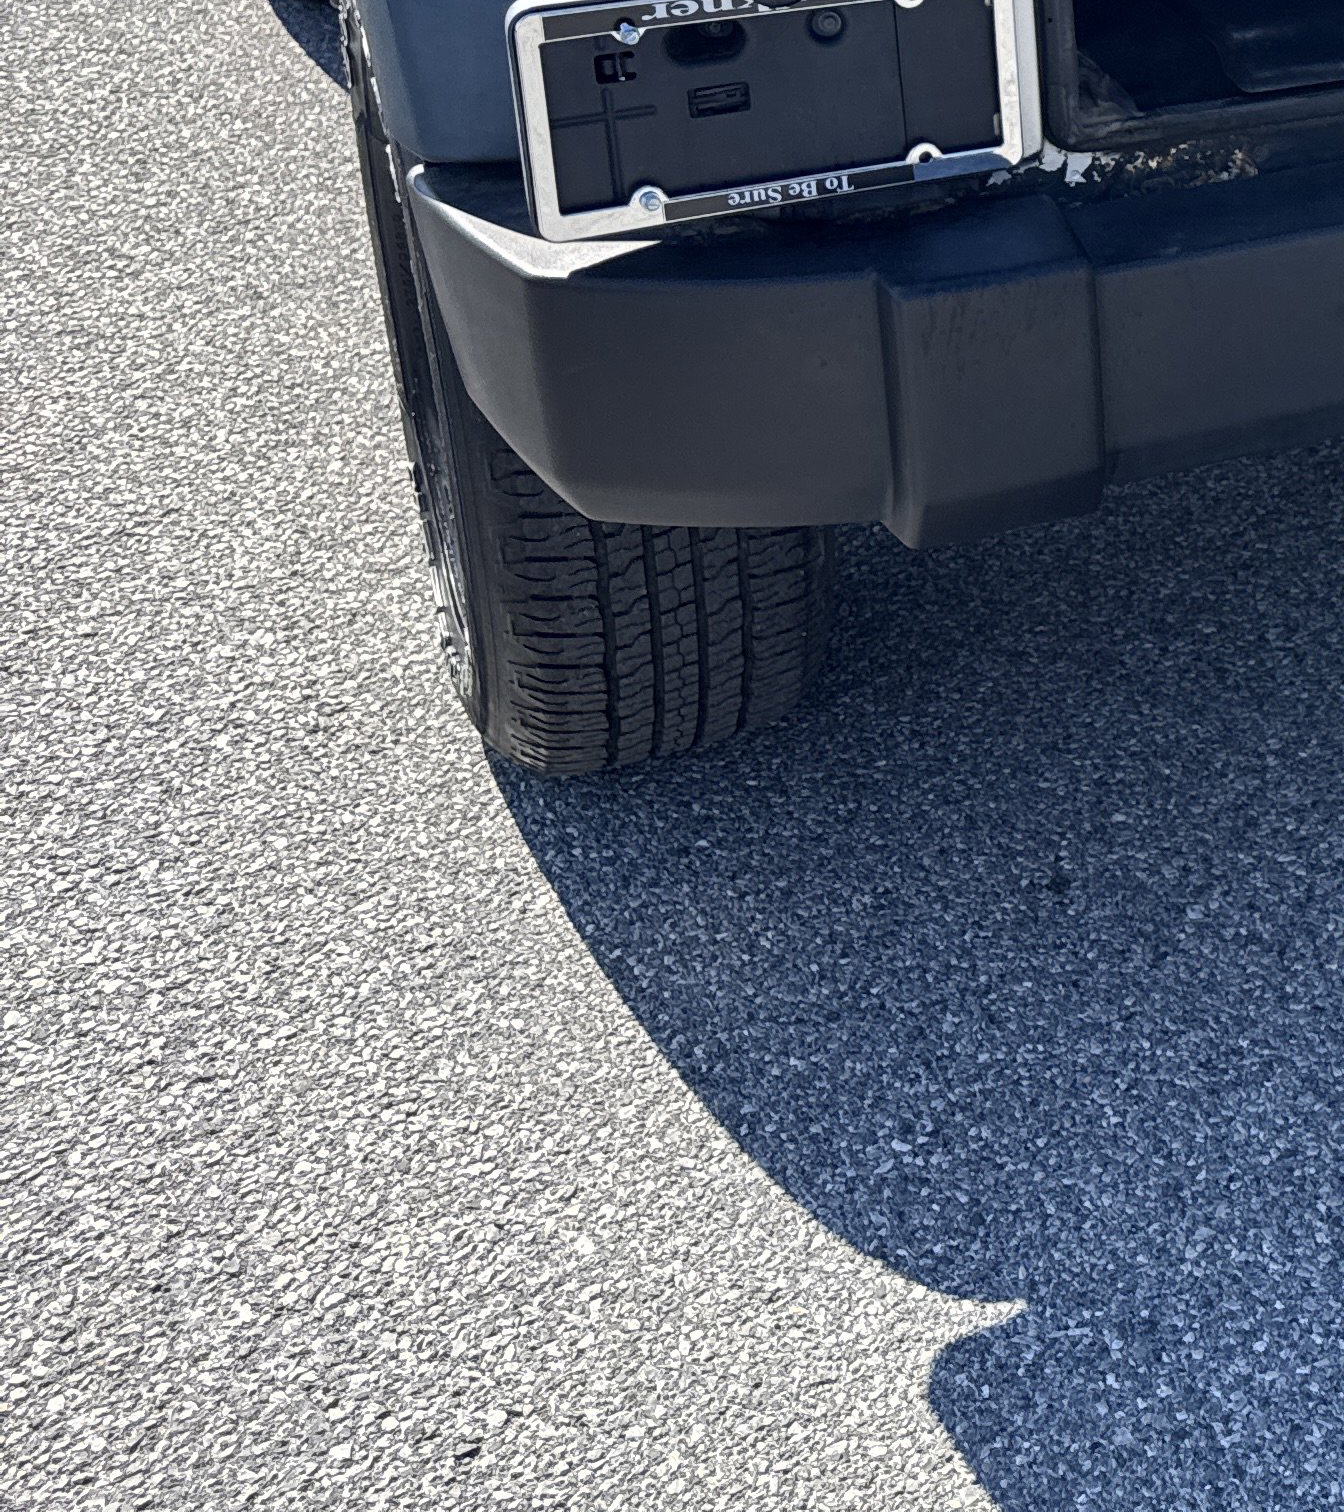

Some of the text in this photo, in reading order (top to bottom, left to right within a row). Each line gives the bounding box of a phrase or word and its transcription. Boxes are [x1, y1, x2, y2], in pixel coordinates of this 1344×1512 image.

[727, 175, 855, 206] To Be Sure
